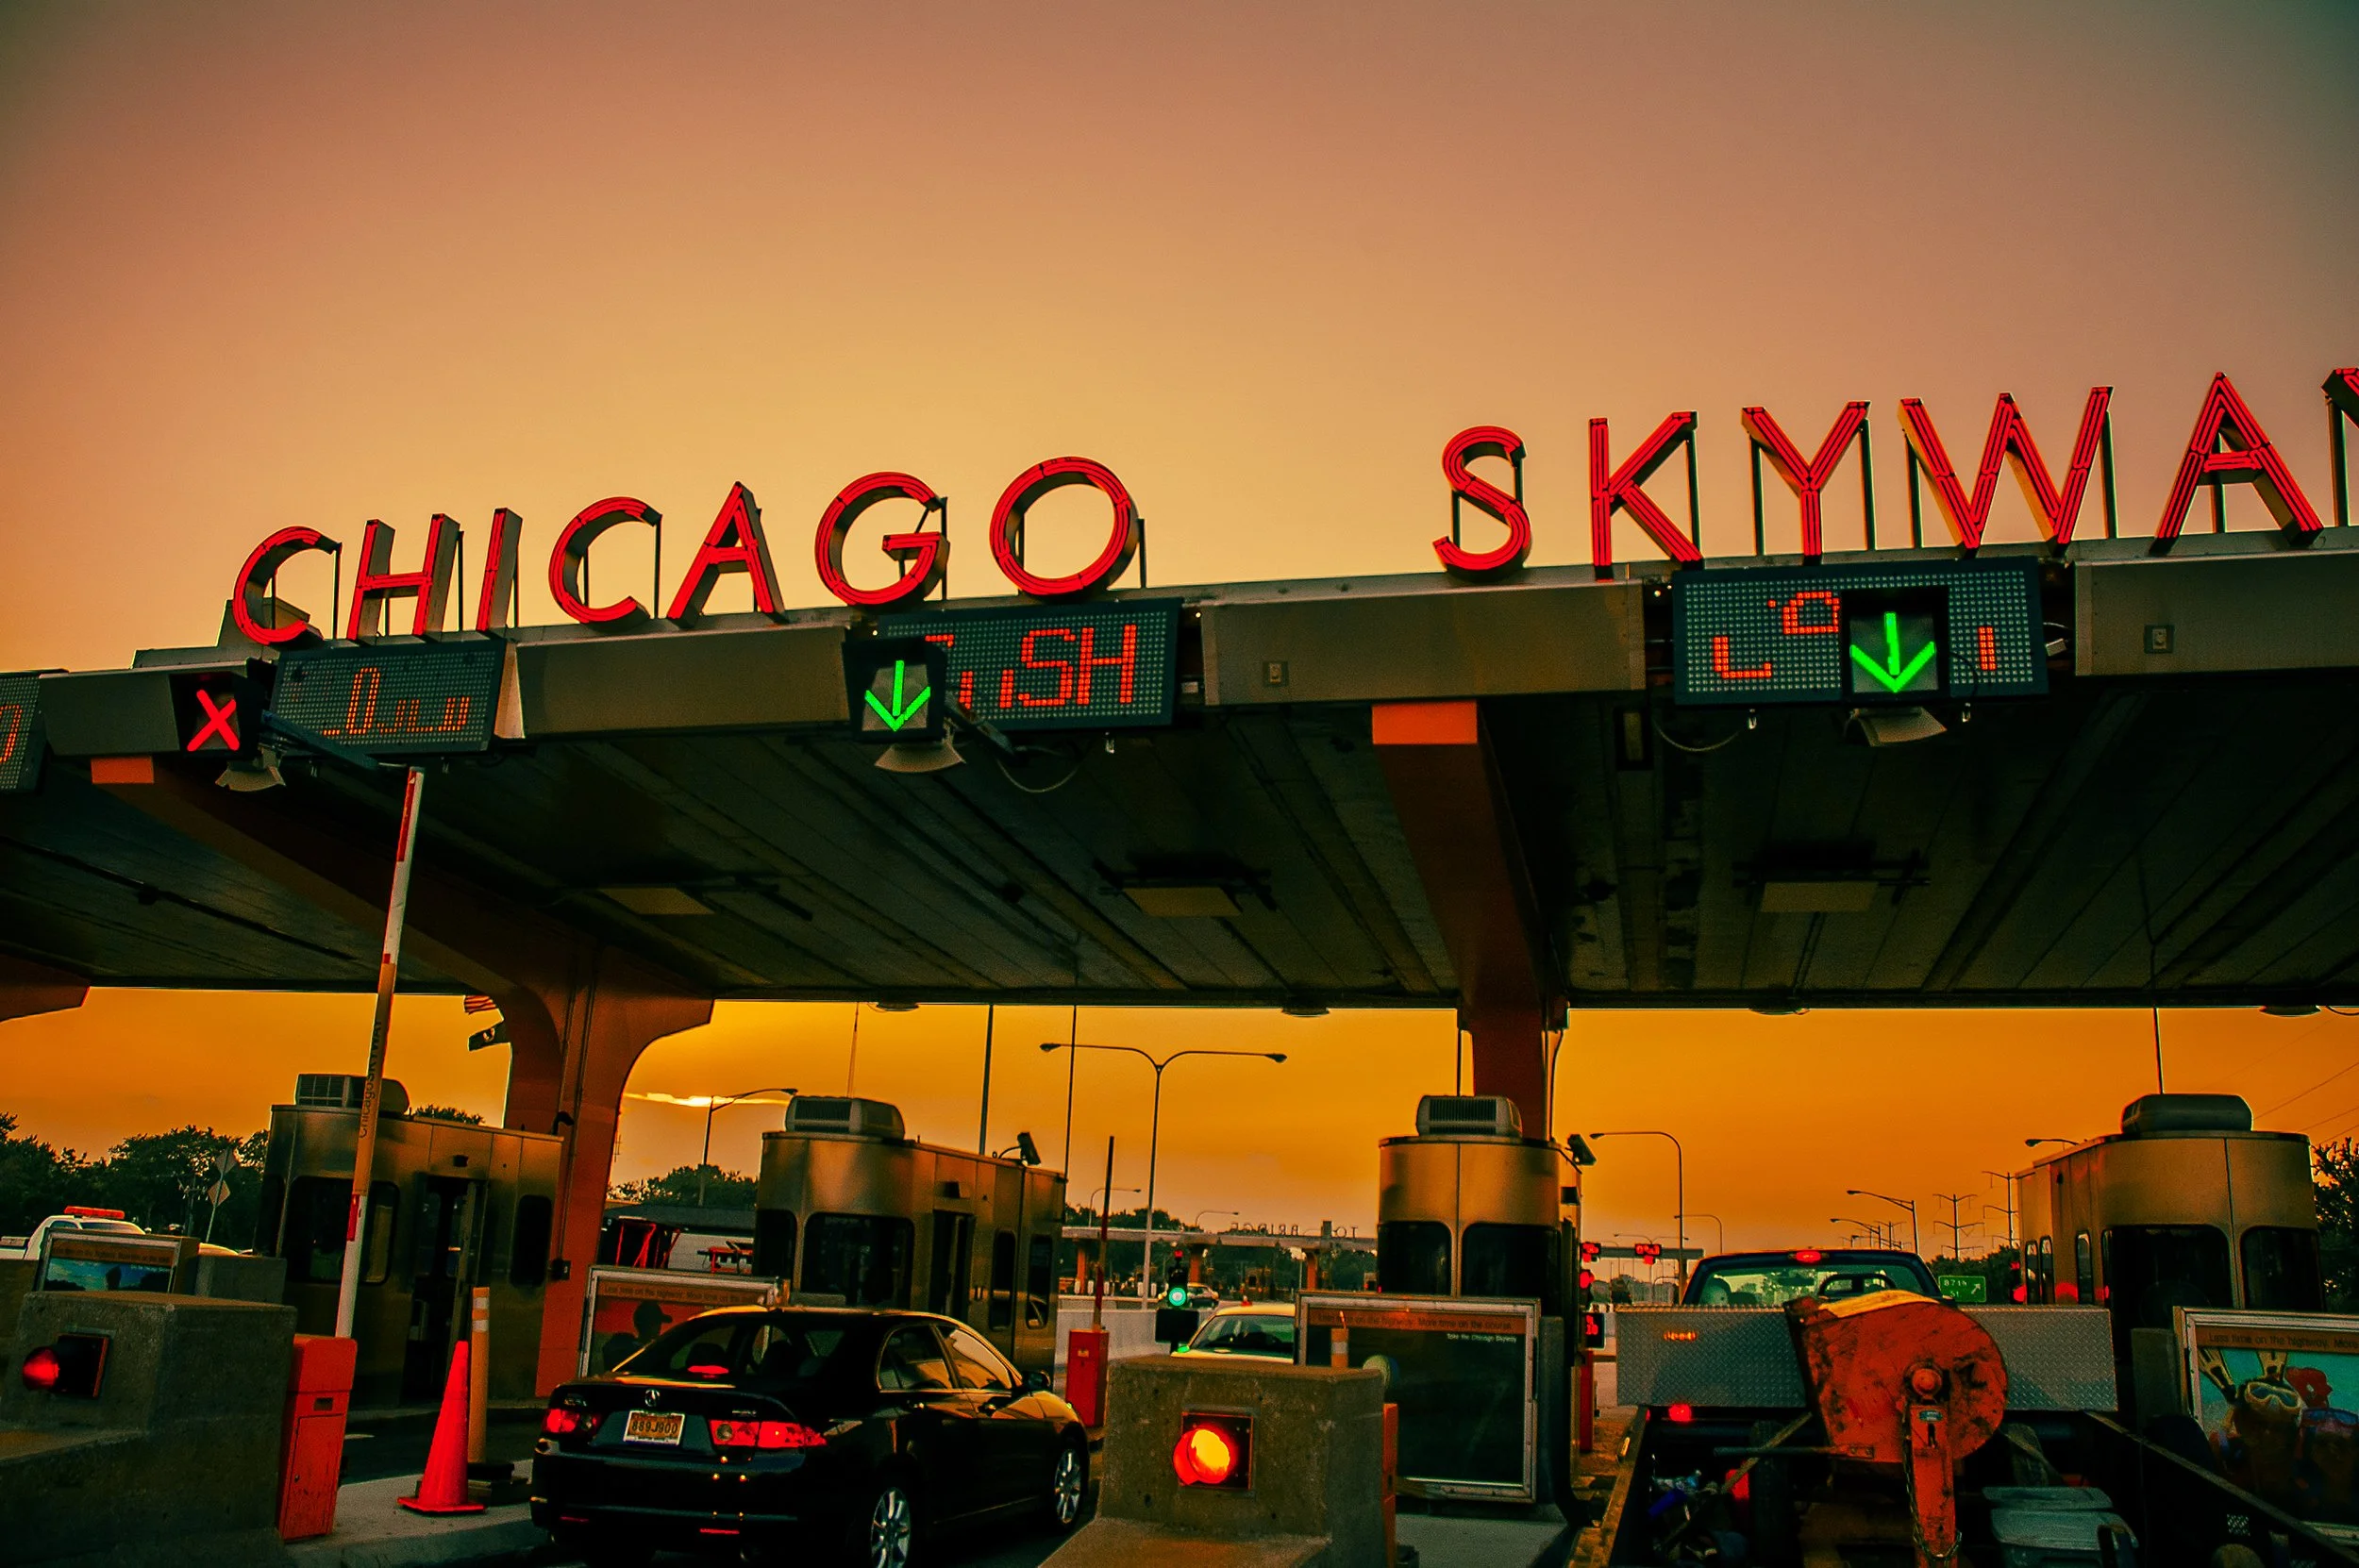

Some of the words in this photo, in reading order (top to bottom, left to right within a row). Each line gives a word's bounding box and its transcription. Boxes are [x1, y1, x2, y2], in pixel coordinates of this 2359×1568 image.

[232, 456, 1140, 646] CHICAGO
[1440, 364, 2359, 573] SKYWA
[2254, 1336, 2267, 1344] on
[2269, 1335, 2285, 1345] the
